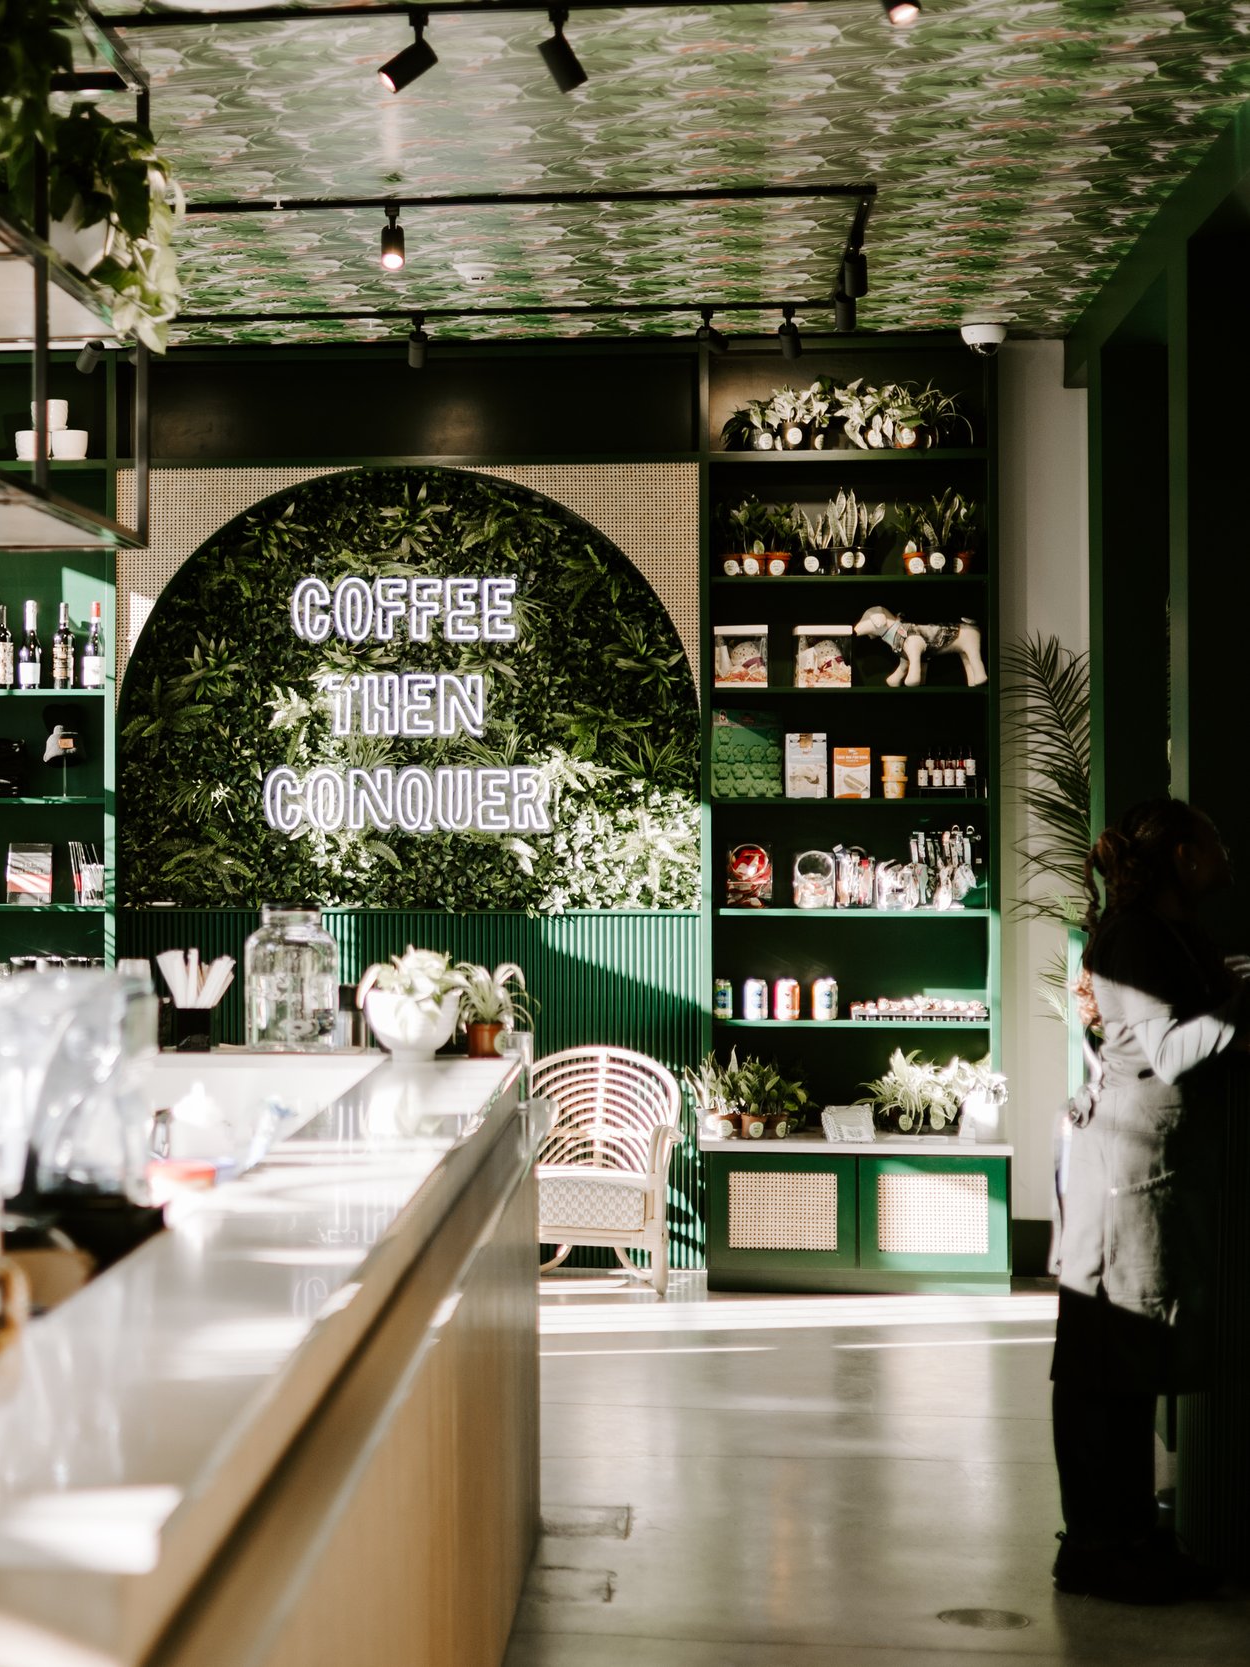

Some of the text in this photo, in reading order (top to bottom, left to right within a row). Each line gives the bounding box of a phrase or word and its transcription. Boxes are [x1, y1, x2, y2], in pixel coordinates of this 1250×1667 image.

[291, 576, 518, 641] COFFEE
[327, 673, 485, 737] THEN
[263, 766, 550, 831] CONQUER
